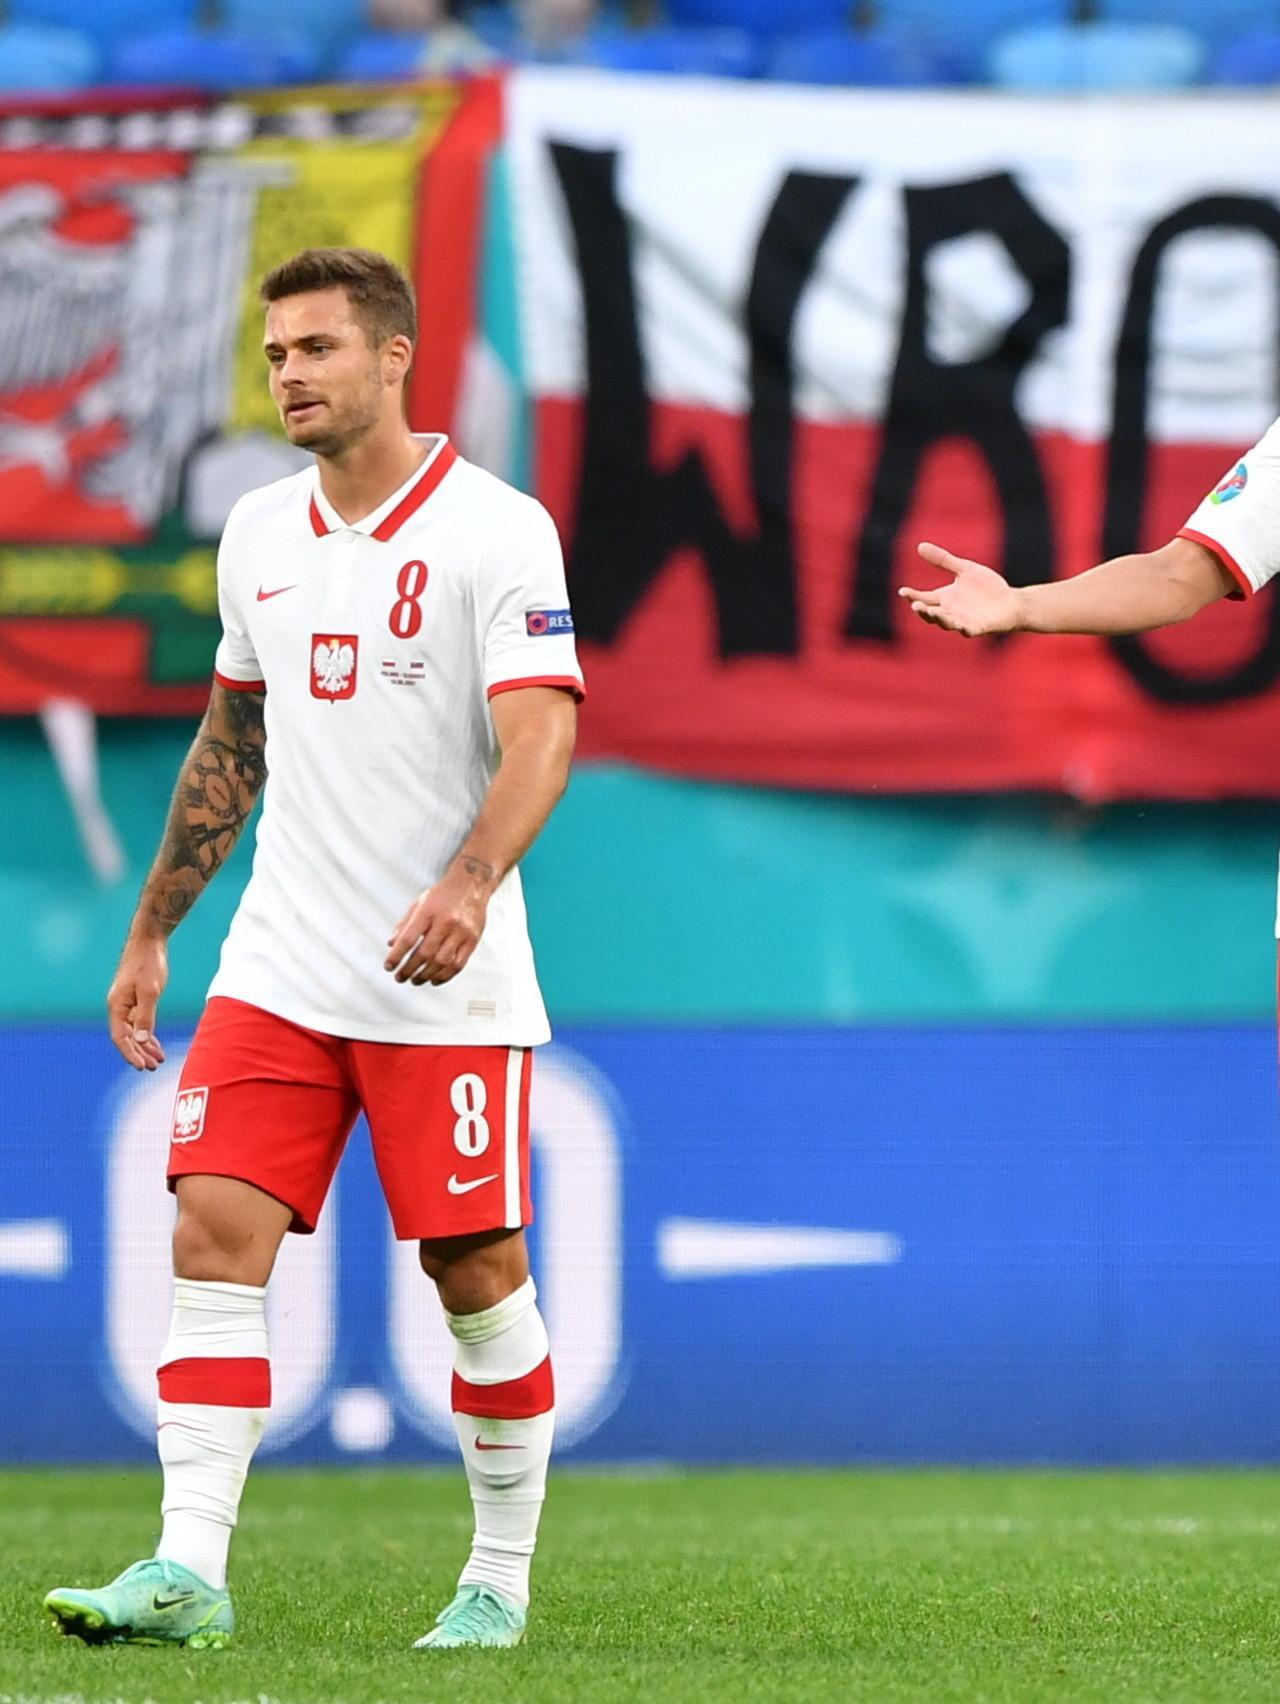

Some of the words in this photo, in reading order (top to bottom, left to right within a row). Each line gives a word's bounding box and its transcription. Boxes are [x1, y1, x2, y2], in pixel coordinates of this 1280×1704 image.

[389, 559, 430, 640] 8
[548, 615, 574, 628] RES
[449, 1073, 490, 1157] 8
